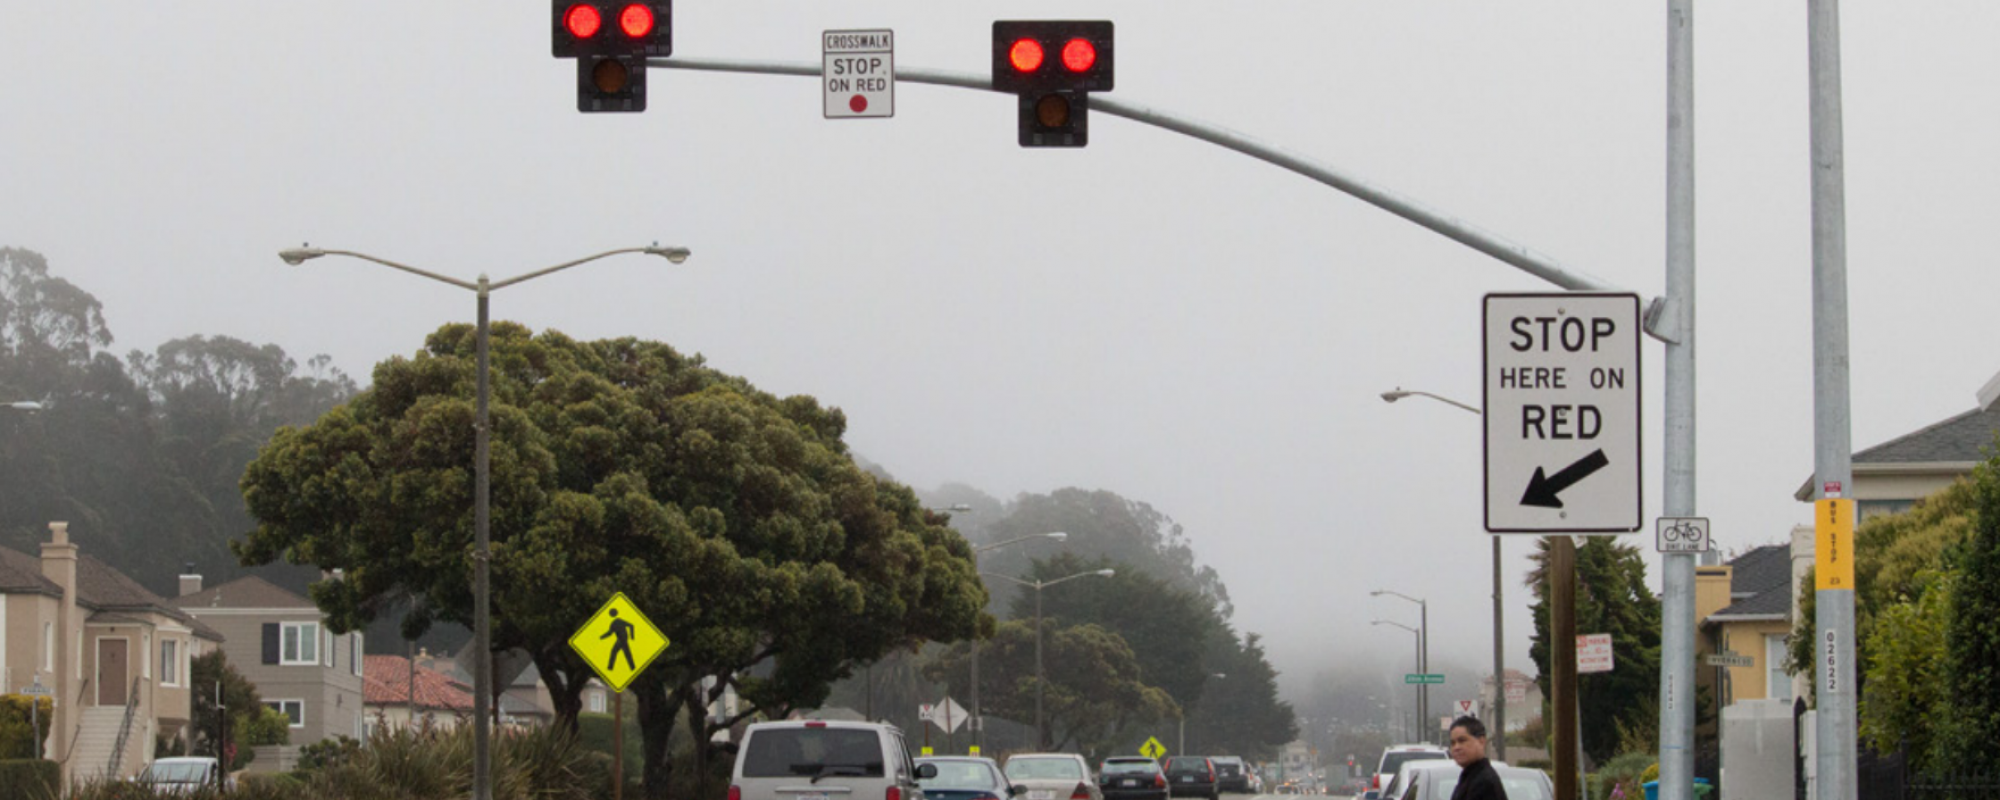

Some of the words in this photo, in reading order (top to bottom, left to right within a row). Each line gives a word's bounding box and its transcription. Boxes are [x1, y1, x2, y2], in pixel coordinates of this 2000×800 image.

[826, 34, 889, 49] CROSSWALK
[834, 58, 882, 75] STOP
[828, 78, 850, 93] ON
[856, 78, 887, 92] RED
[1510, 316, 1616, 352] STOP
[1500, 367, 1567, 389] HERE
[1590, 367, 1625, 389] ON
[1522, 404, 1602, 440] RED
[1829, 501, 1837, 525] BUS
[1682, 542, 1700, 551] LANE
[1829, 532, 1837, 564] STOP
[1826, 631, 1836, 690] 02622
